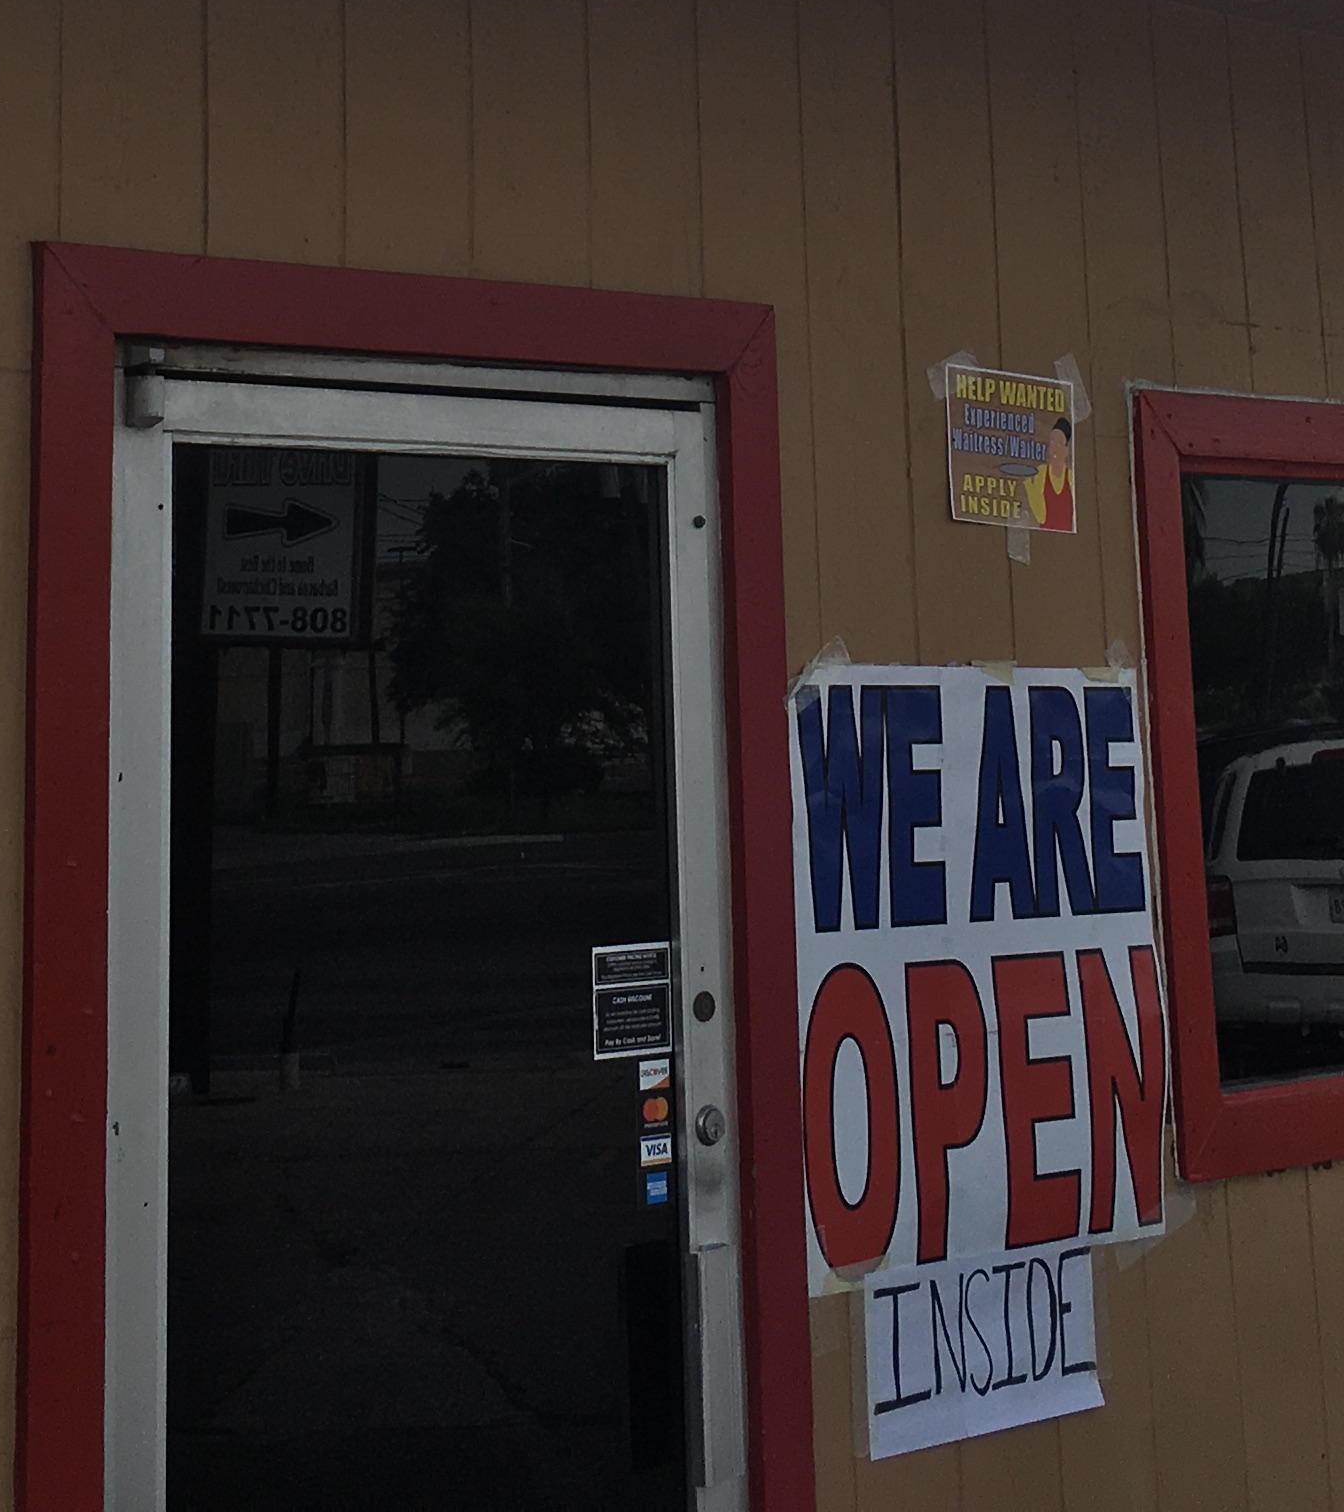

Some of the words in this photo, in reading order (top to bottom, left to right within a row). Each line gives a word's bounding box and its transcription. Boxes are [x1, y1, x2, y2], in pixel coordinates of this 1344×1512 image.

[956, 374, 996, 402] HELP
[999, 380, 1065, 413] WANTED
[964, 403, 1035, 434] Experienced
[953, 428, 1047, 461] Waitress/Waiter
[963, 474, 1017, 497] APPLY
[960, 494, 1021, 519] INSIDE
[794, 684, 947, 934] WE
[969, 684, 1146, 923] ARE
[803, 944, 1167, 1283] OPEN
[646, 1143, 668, 1156] VISA
[874, 1246, 1097, 1416] INSIDE
